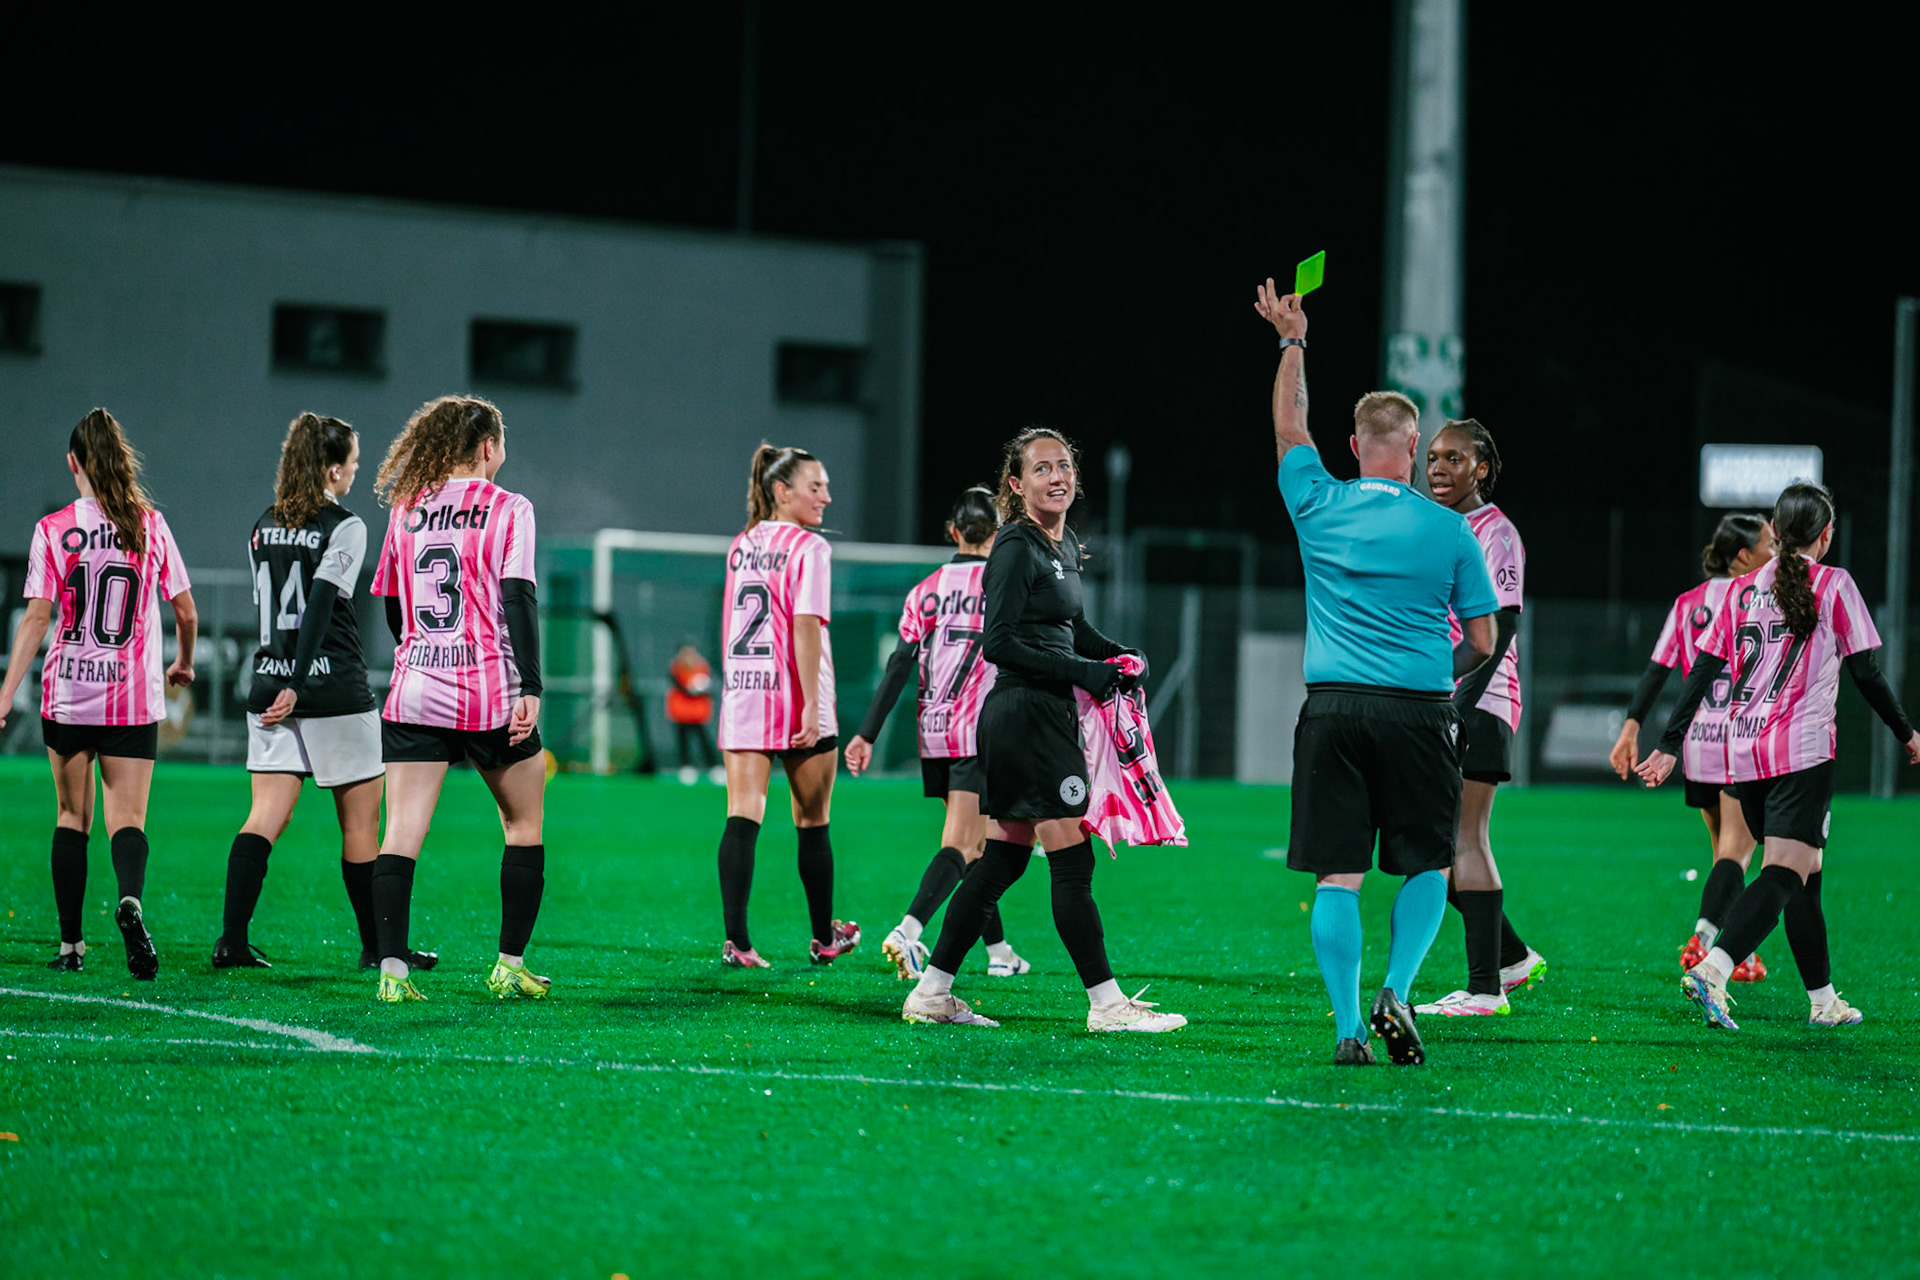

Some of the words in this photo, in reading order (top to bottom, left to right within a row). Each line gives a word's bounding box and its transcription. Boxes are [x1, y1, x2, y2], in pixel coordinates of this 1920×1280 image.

[1360, 482, 1401, 497] GAUDARD
[404, 504, 490, 533] Orllati
[61, 523, 147, 553] Orlli
[261, 527, 321, 549] TELFAG
[730, 546, 789, 572] Orllati
[415, 543, 464, 634] 3
[57, 561, 143, 650] 10
[257, 560, 307, 647] 14
[921, 590, 986, 617] Orllat
[728, 581, 774, 659] 2
[59, 655, 74, 679] LE
[77, 659, 126, 682] FRANC
[409, 643, 477, 668] GIRARDIN
[918, 625, 984, 704] 17
[1731, 621, 1812, 706] 27
